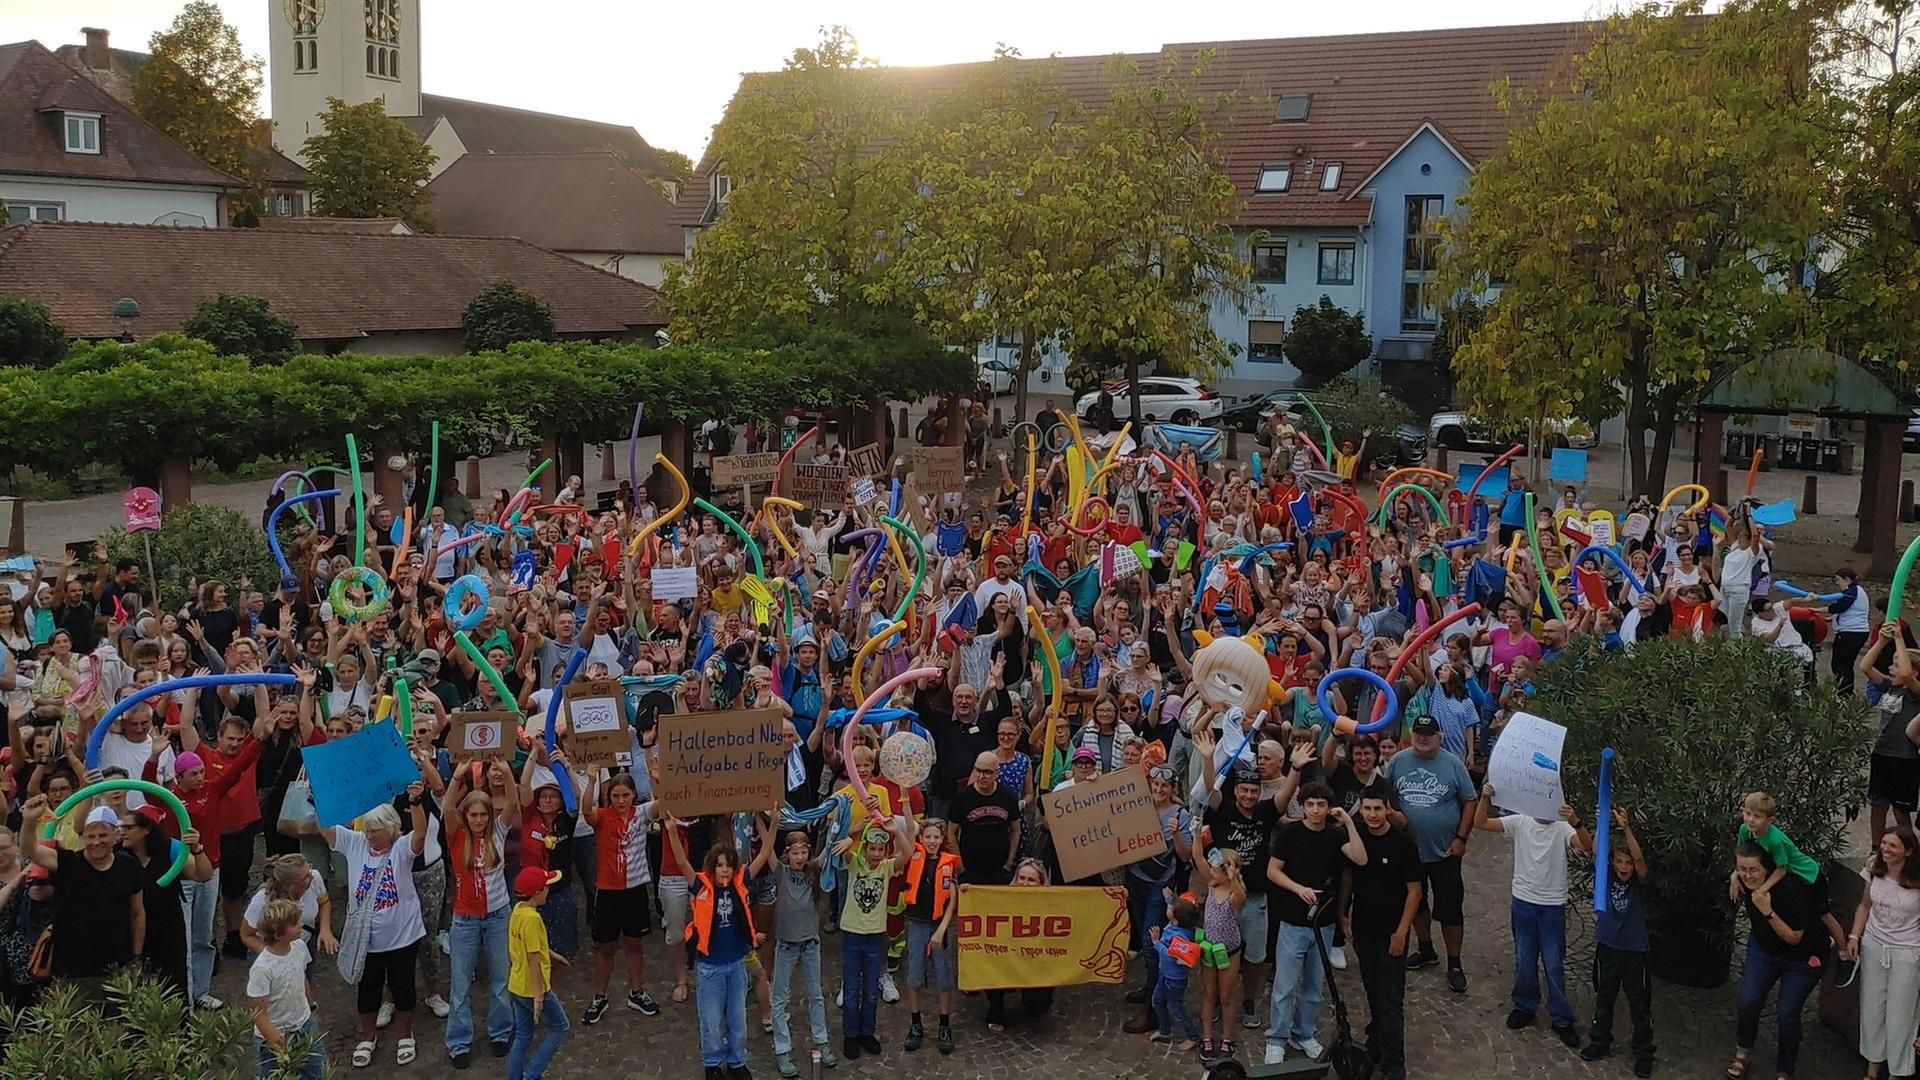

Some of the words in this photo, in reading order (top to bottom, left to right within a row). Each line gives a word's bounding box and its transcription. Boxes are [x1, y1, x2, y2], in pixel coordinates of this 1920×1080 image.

[669, 727, 755, 752] Hallenbad
[664, 785, 691, 801] auch
[698, 783, 772, 799] Finanzierung
[1054, 782, 1136, 818] Schwimmen
[1110, 795, 1152, 815] lernen
[1072, 821, 1114, 849] rettet
[1116, 831, 1163, 854] Leben
